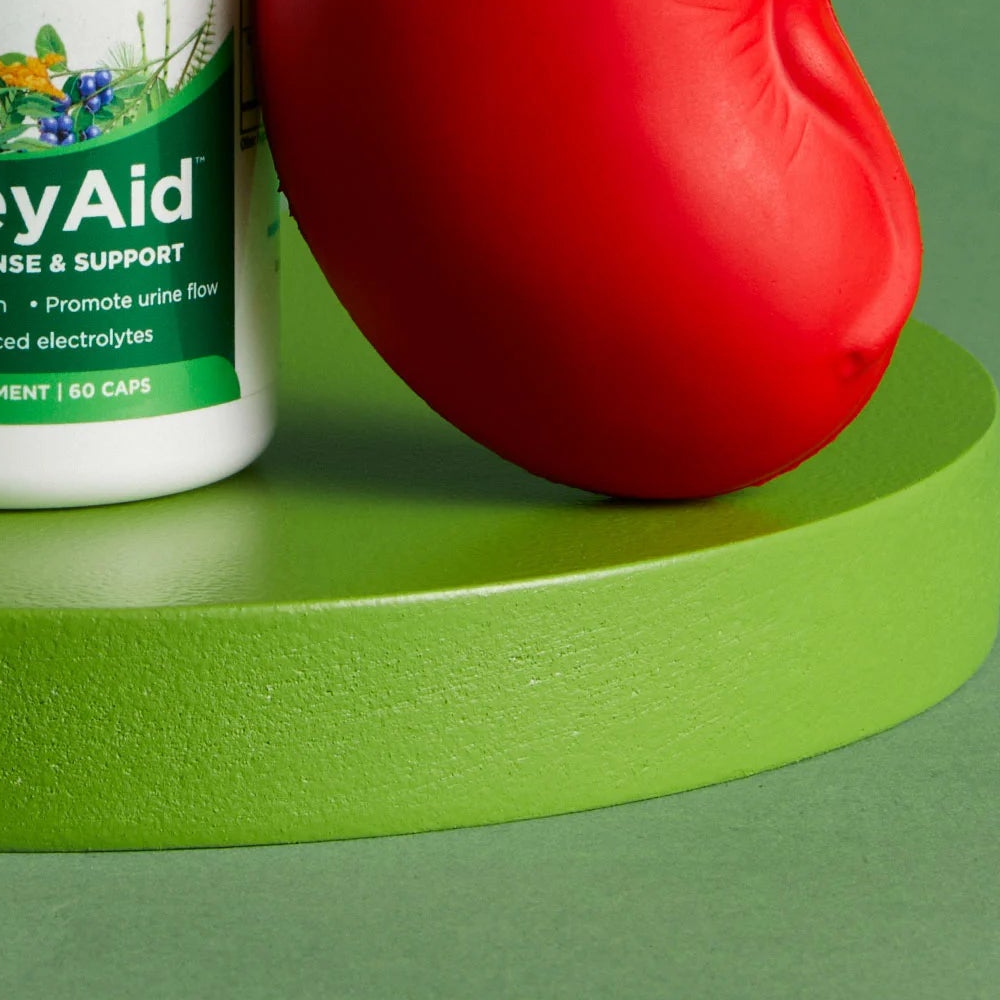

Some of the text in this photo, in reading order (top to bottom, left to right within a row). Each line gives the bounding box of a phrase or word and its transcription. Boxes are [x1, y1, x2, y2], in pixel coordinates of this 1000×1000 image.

[49, 254, 67, 273] &
[74, 243, 185, 272] SUPPORT
[46, 282, 219, 313] Promote urine flow
[36, 328, 154, 350] electrolytes
[68, 382, 96, 400] 60
[101, 377, 152, 398] CAPS
